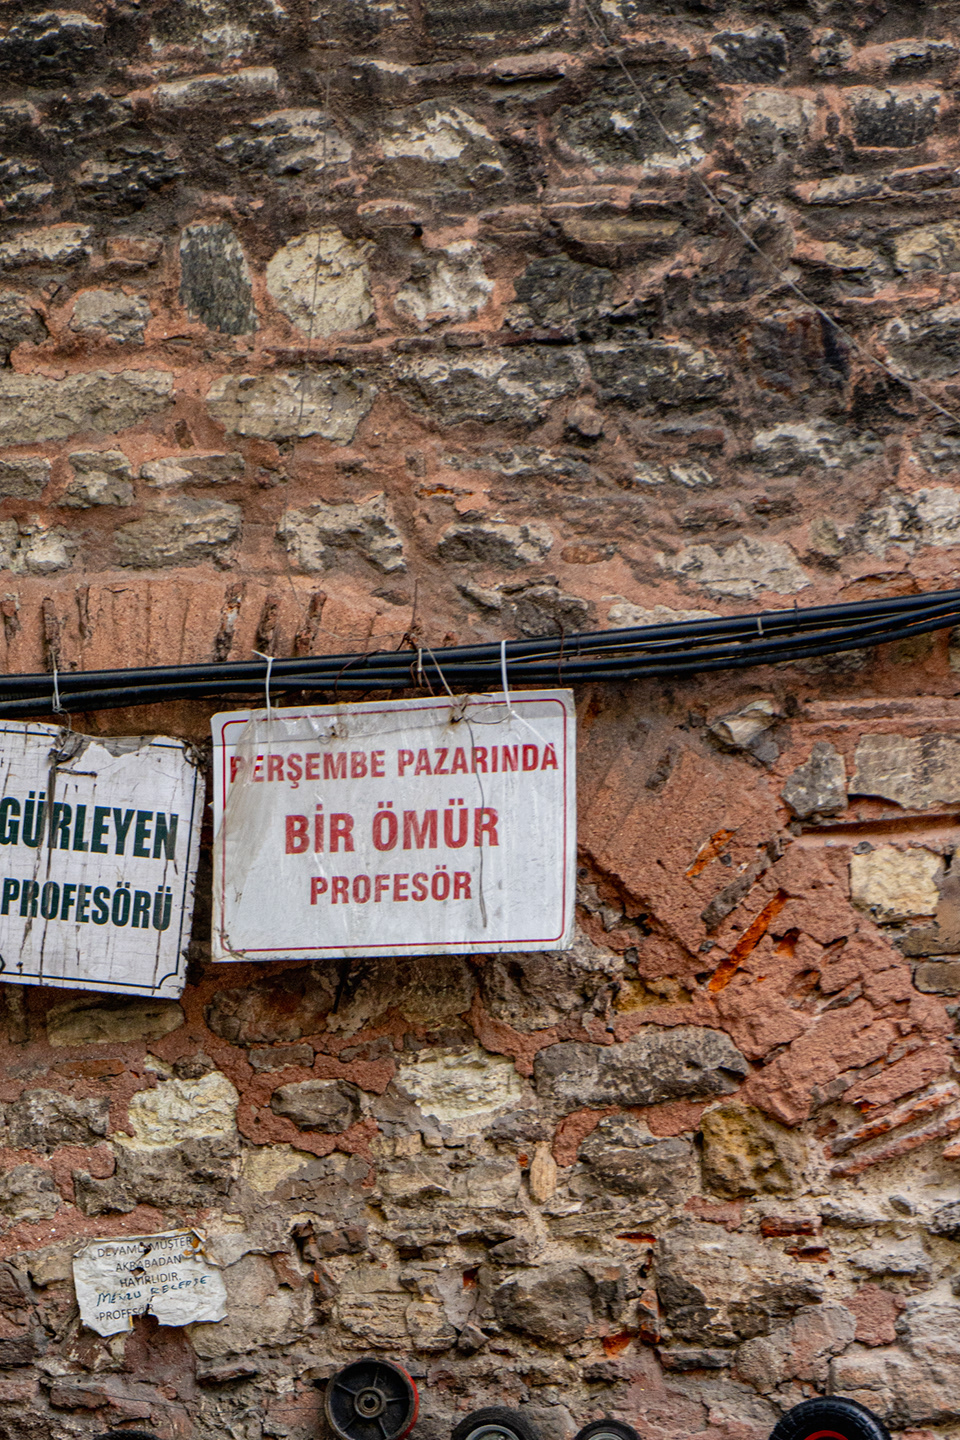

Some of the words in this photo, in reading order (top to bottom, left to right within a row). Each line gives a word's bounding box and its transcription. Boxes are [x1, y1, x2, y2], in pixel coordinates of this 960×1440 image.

[229, 750, 386, 789] PERŞEMBE
[397, 743, 560, 777] PAZARINDA
[285, 803, 356, 855] BİR
[372, 798, 500, 852] ÖMÜR
[0, 877, 173, 932] PROFESÖRÜ
[310, 865, 472, 906] PROFESÖR
